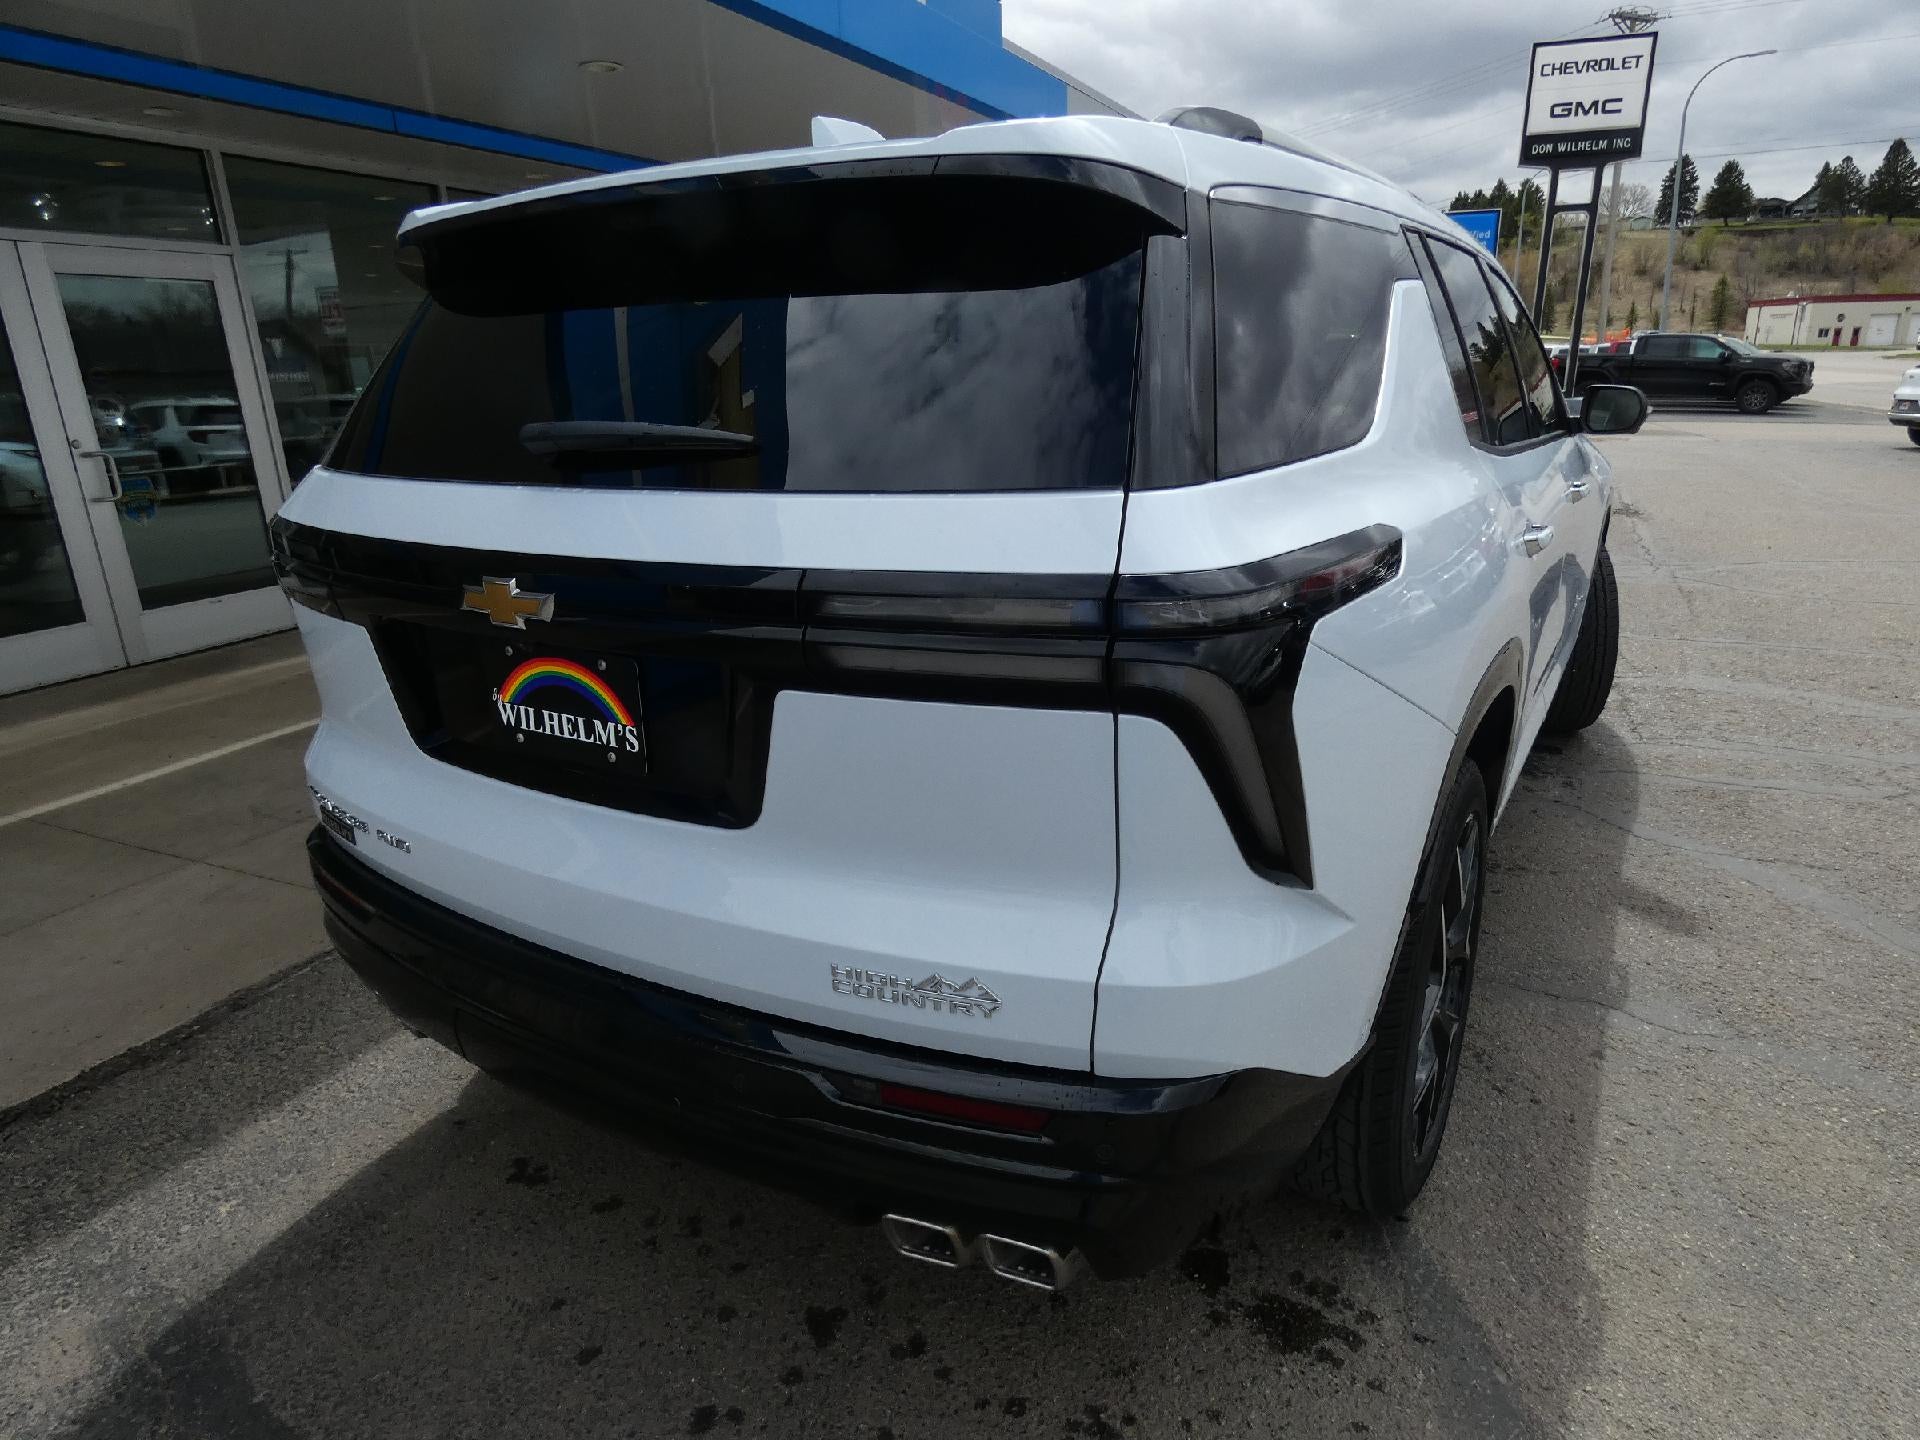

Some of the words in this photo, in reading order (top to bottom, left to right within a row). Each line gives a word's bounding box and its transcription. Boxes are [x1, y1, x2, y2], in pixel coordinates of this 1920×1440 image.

[1540, 55, 1644, 77] CHEVROLET
[1549, 98, 1623, 118] GMC
[1531, 144, 1553, 155] DON
[1557, 139, 1608, 152] WILHELM
[1612, 138, 1631, 149] INC
[497, 701, 640, 753] WILHELM'S
[831, 963, 912, 990] HIGH
[832, 979, 1000, 1018] COUNTRY
